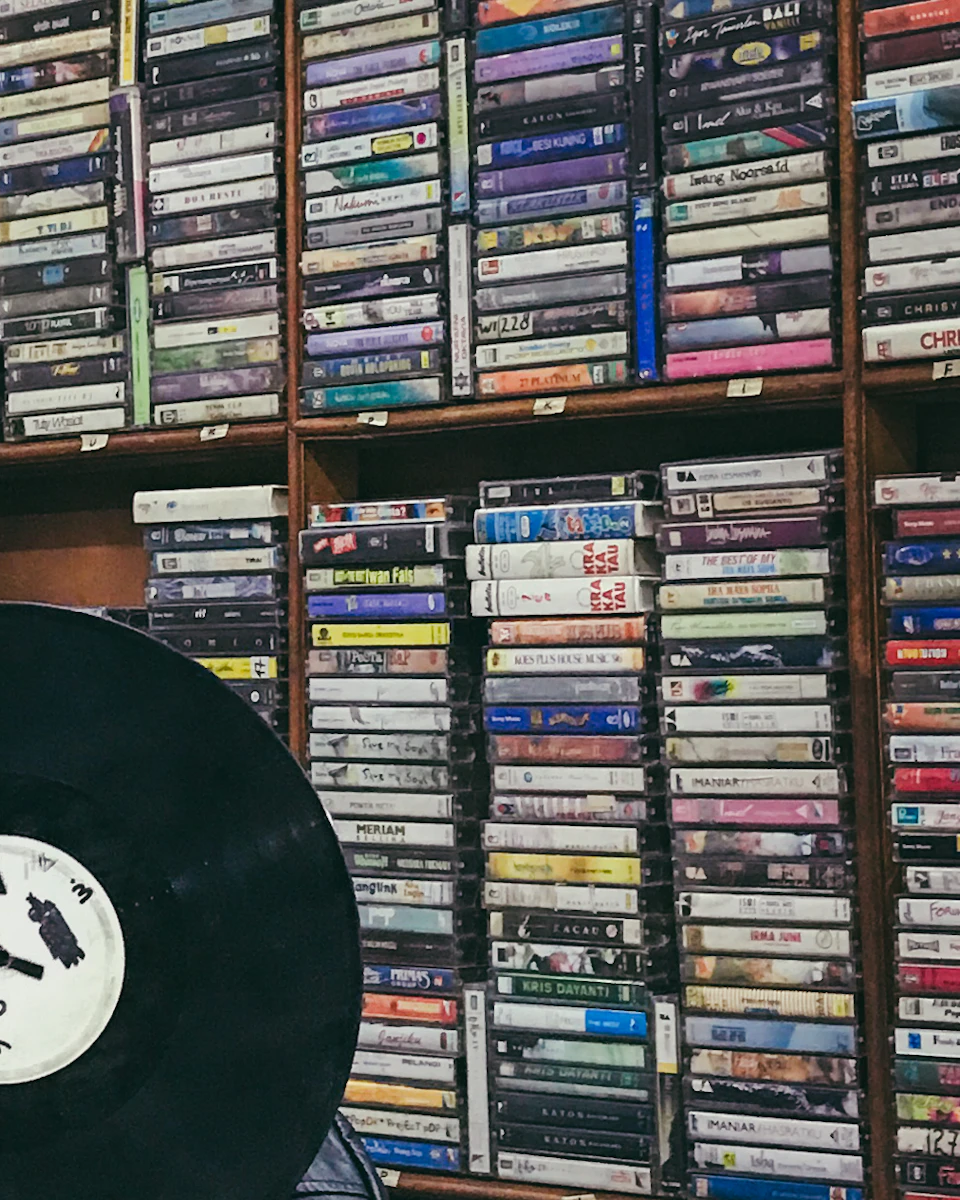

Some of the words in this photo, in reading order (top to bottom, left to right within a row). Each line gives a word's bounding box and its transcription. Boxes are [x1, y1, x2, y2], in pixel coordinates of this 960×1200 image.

[762, 2, 800, 21] BALI
[689, 170, 725, 187] Iwang
[730, 161, 789, 181] Noorsaid
[943, 363, 953, 376] F
[530, 371, 581, 388] PLATINUM
[583, 543, 595, 575] KRA
[594, 551, 606, 575] KA
[607, 544, 619, 573] TAU
[392, 566, 414, 584] Fals
[590, 579, 602, 612] KRA
[602, 588, 614, 612] KA
[615, 582, 627, 610] TAU
[557, 654, 585, 665] HOUSE
[586, 653, 611, 664] MUSIC
[356, 823, 405, 837] MERIAM
[750, 930, 775, 942] IRMA
[522, 982, 552, 995] KRIS
[557, 983, 610, 998] DAYANTI
[707, 1120, 756, 1133] IMANIAR
